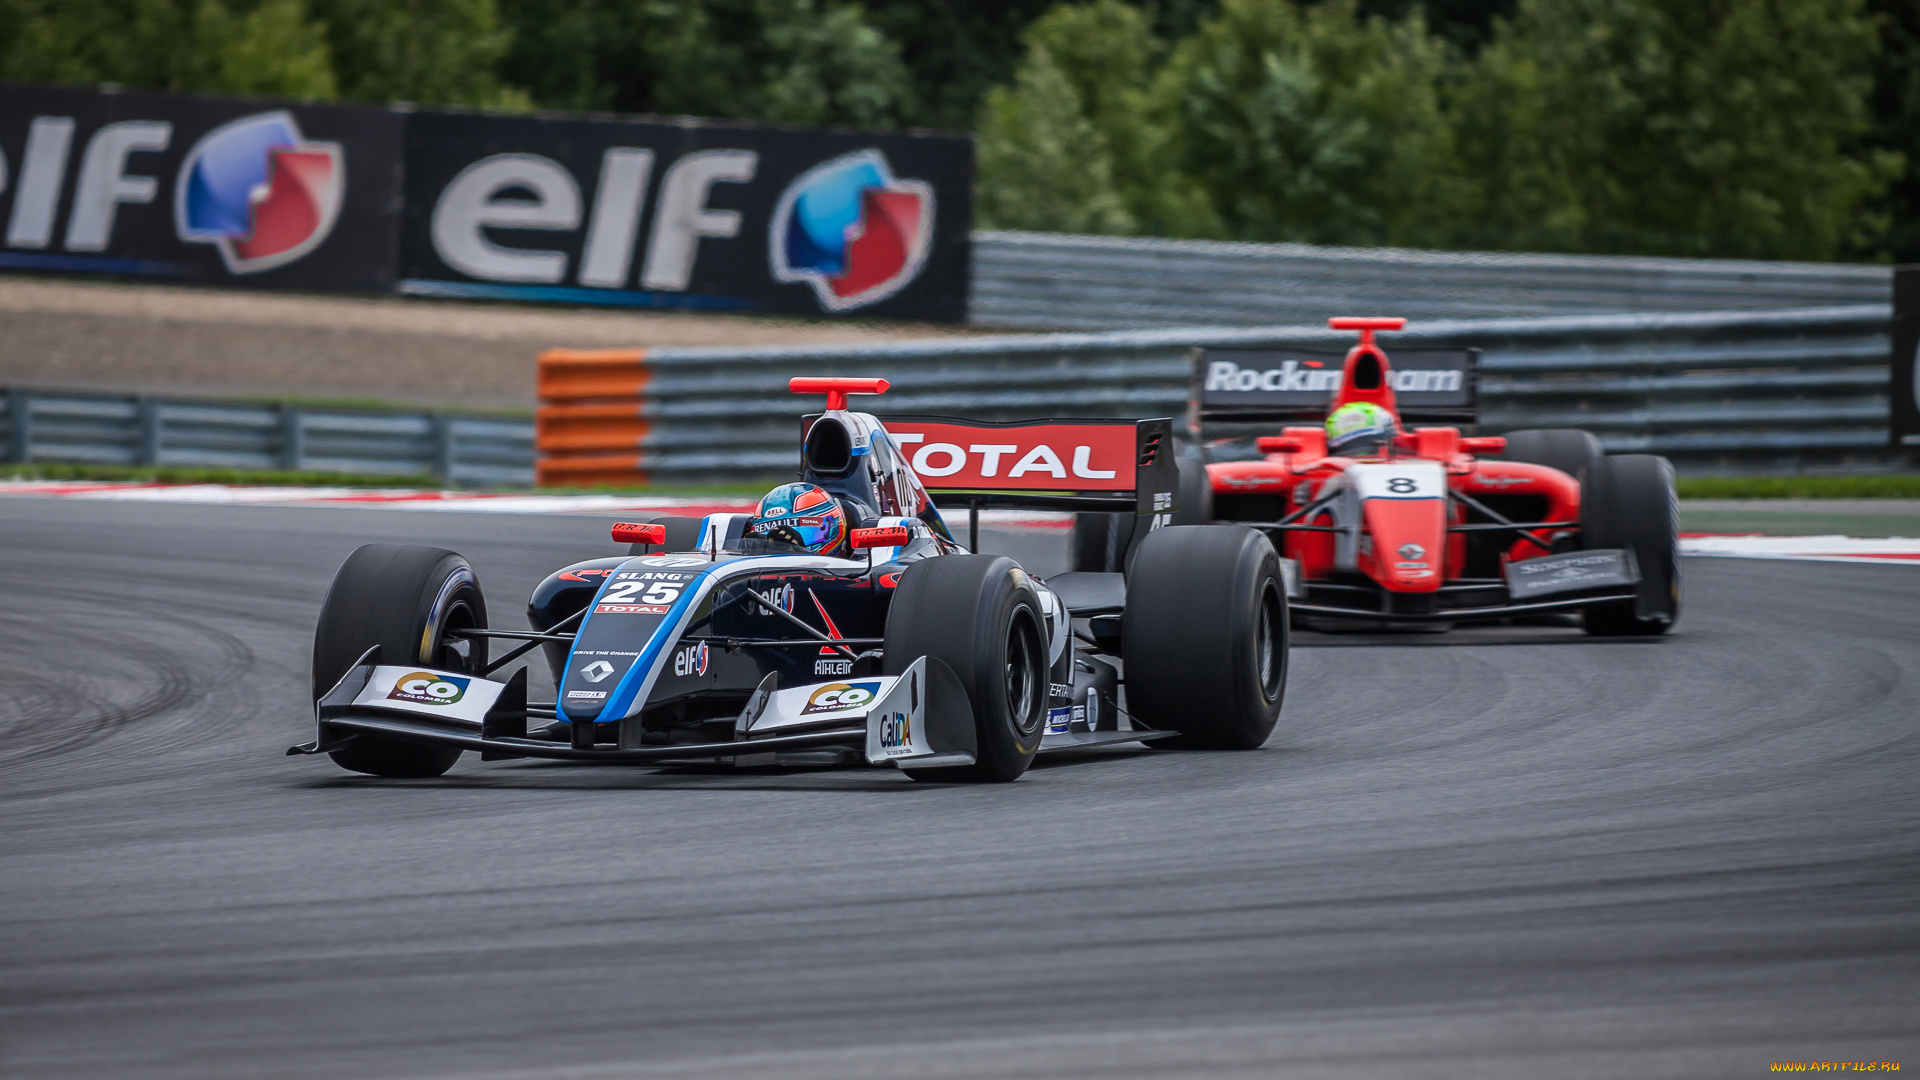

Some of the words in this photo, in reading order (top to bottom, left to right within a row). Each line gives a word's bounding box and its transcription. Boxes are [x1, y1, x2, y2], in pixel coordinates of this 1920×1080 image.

[0, 116, 173, 252] lf
[431, 146, 759, 292] elf
[1204, 360, 1464, 391] Rockinam
[889, 433, 1116, 479] TOTAL
[1386, 477, 1417, 493] 8
[766, 508, 784, 516] BELL
[754, 517, 800, 533] RENAULT
[616, 572, 682, 581] SLANG
[598, 581, 685, 605] 25
[759, 587, 782, 616] elf
[601, 605, 664, 613] TOTAL
[675, 645, 697, 677] elf
[402, 679, 459, 698] CO
[814, 689, 870, 706] CO
[396, 693, 452, 704] COLOMBIA
[809, 702, 864, 712] COLOMBIA
